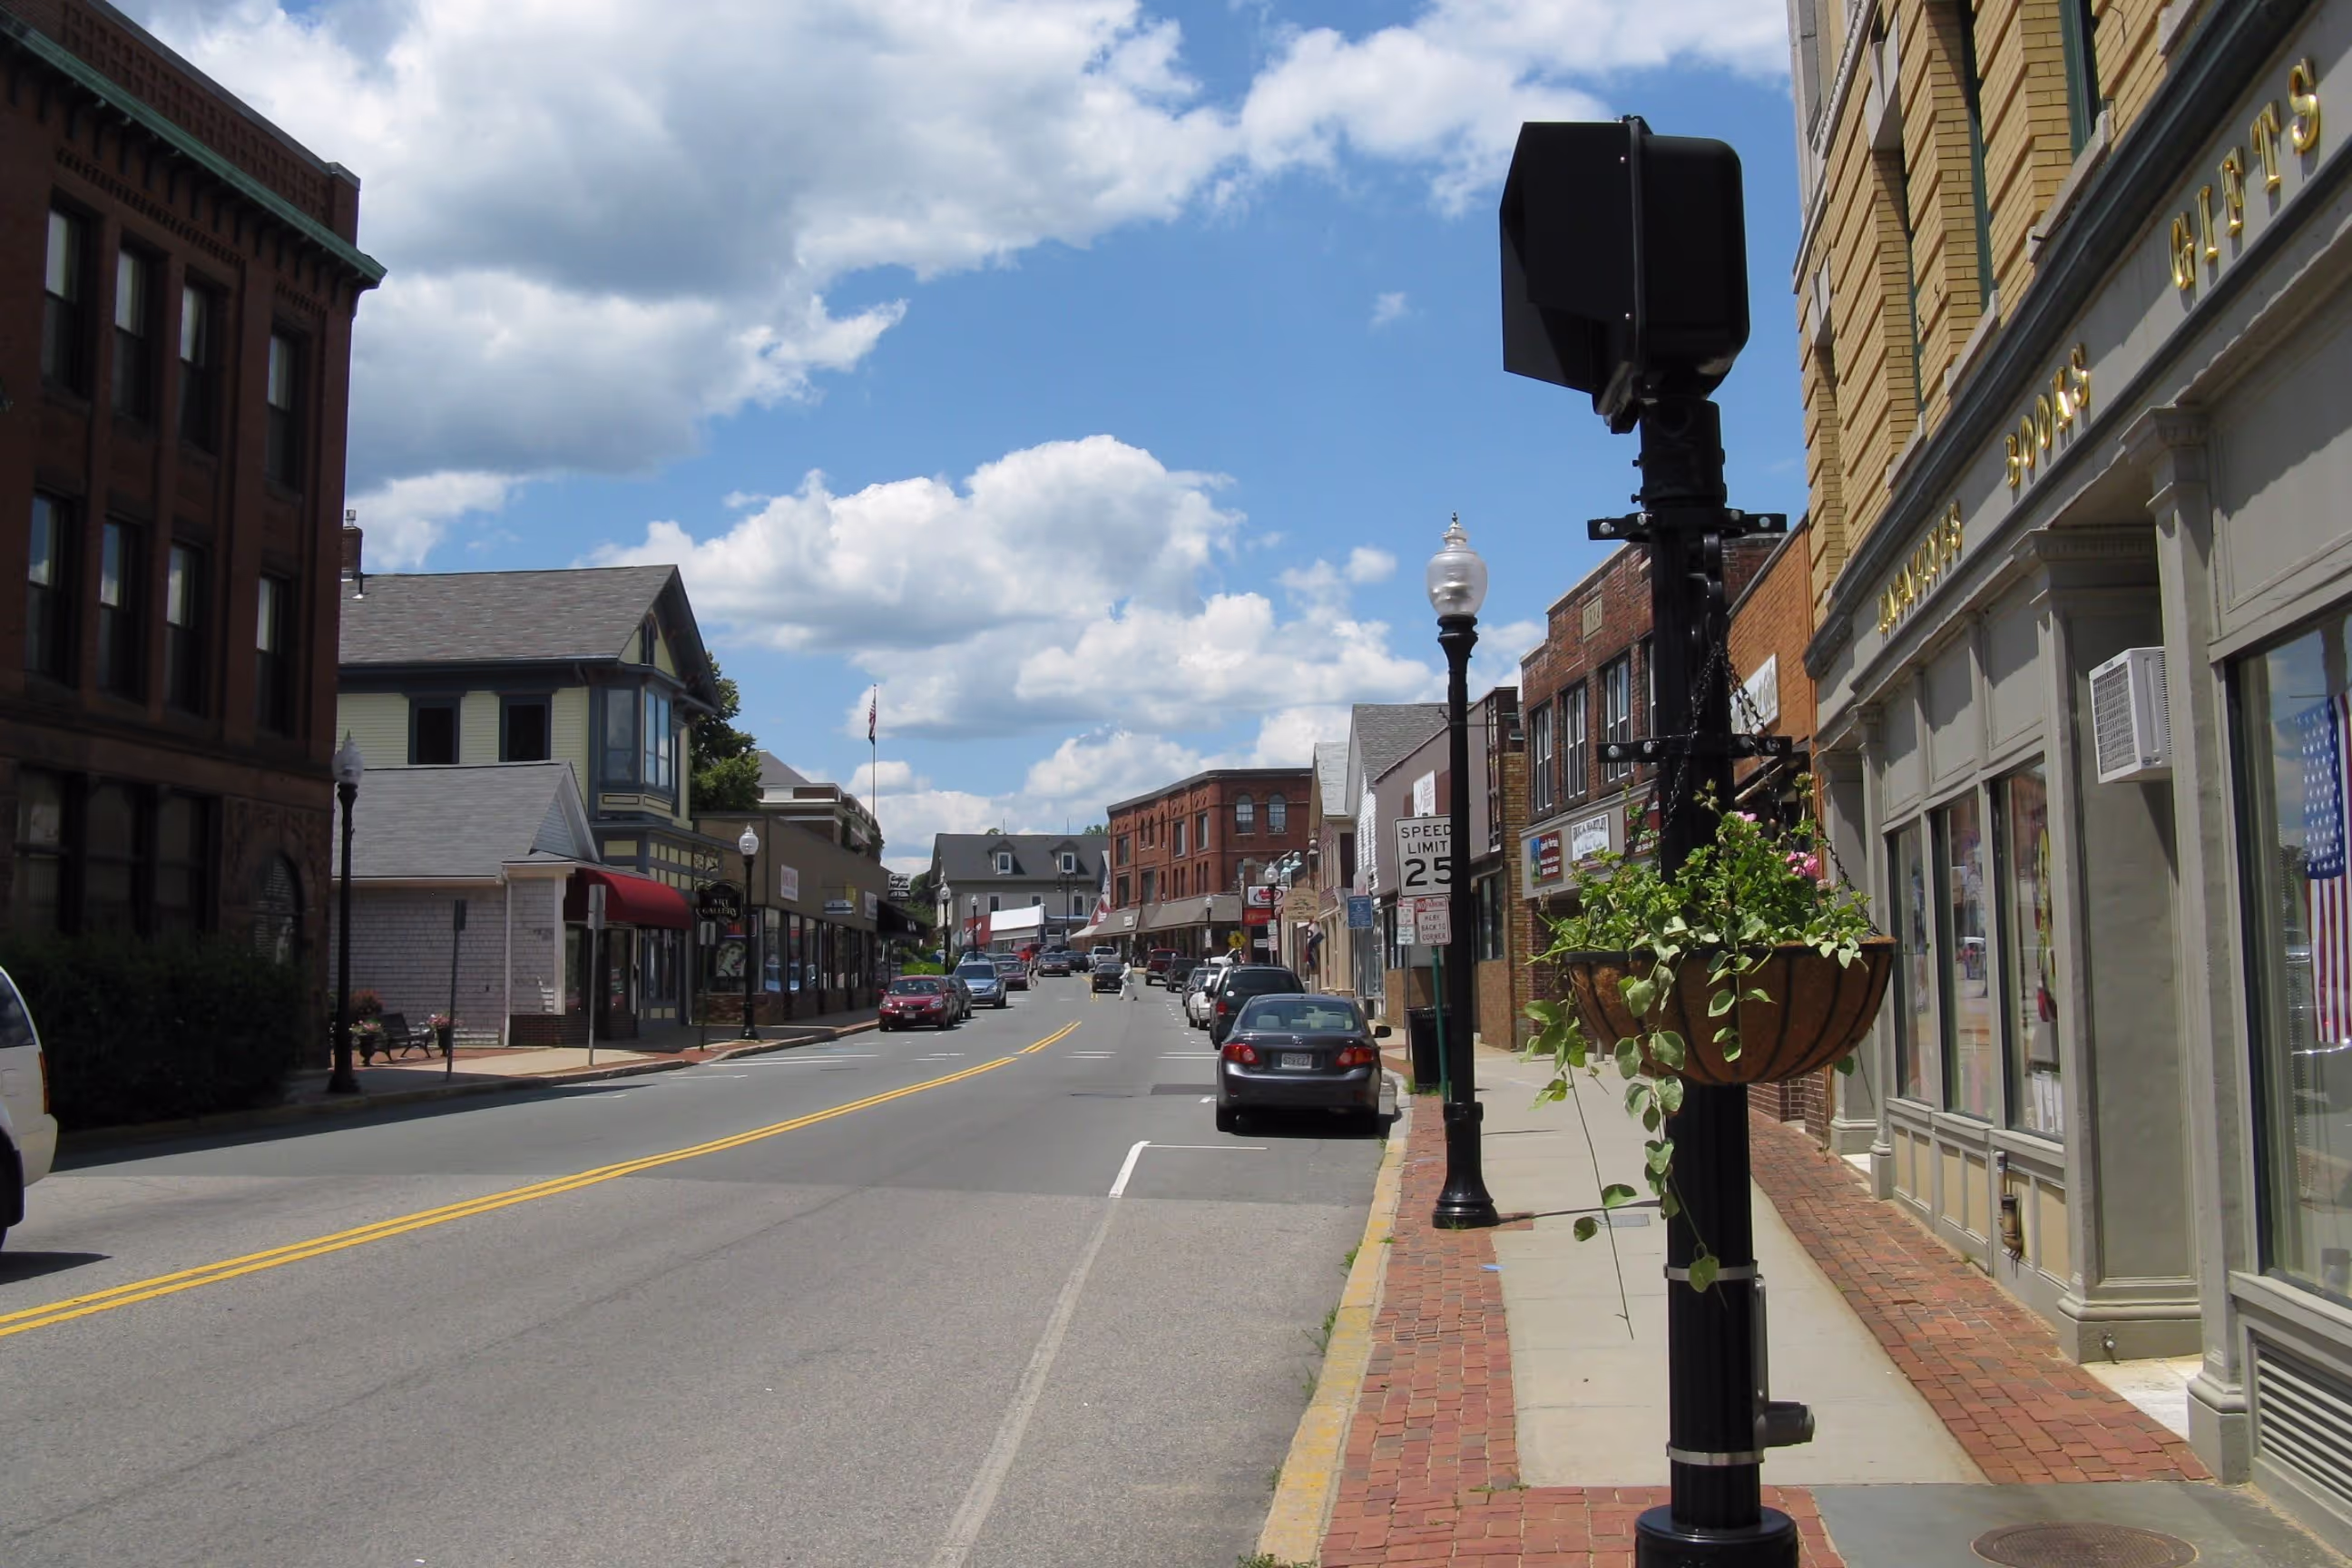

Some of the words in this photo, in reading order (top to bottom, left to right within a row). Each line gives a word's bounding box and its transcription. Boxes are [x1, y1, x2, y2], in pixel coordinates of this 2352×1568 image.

[2004, 342, 2090, 487] BOOKS
[2171, 58, 2320, 290] GIFTS
[1401, 824, 1452, 838] SPEED
[1407, 840, 1447, 854] LIMIT
[1405, 857, 1452, 887] 25
[1422, 933, 1446, 941] CORNER
